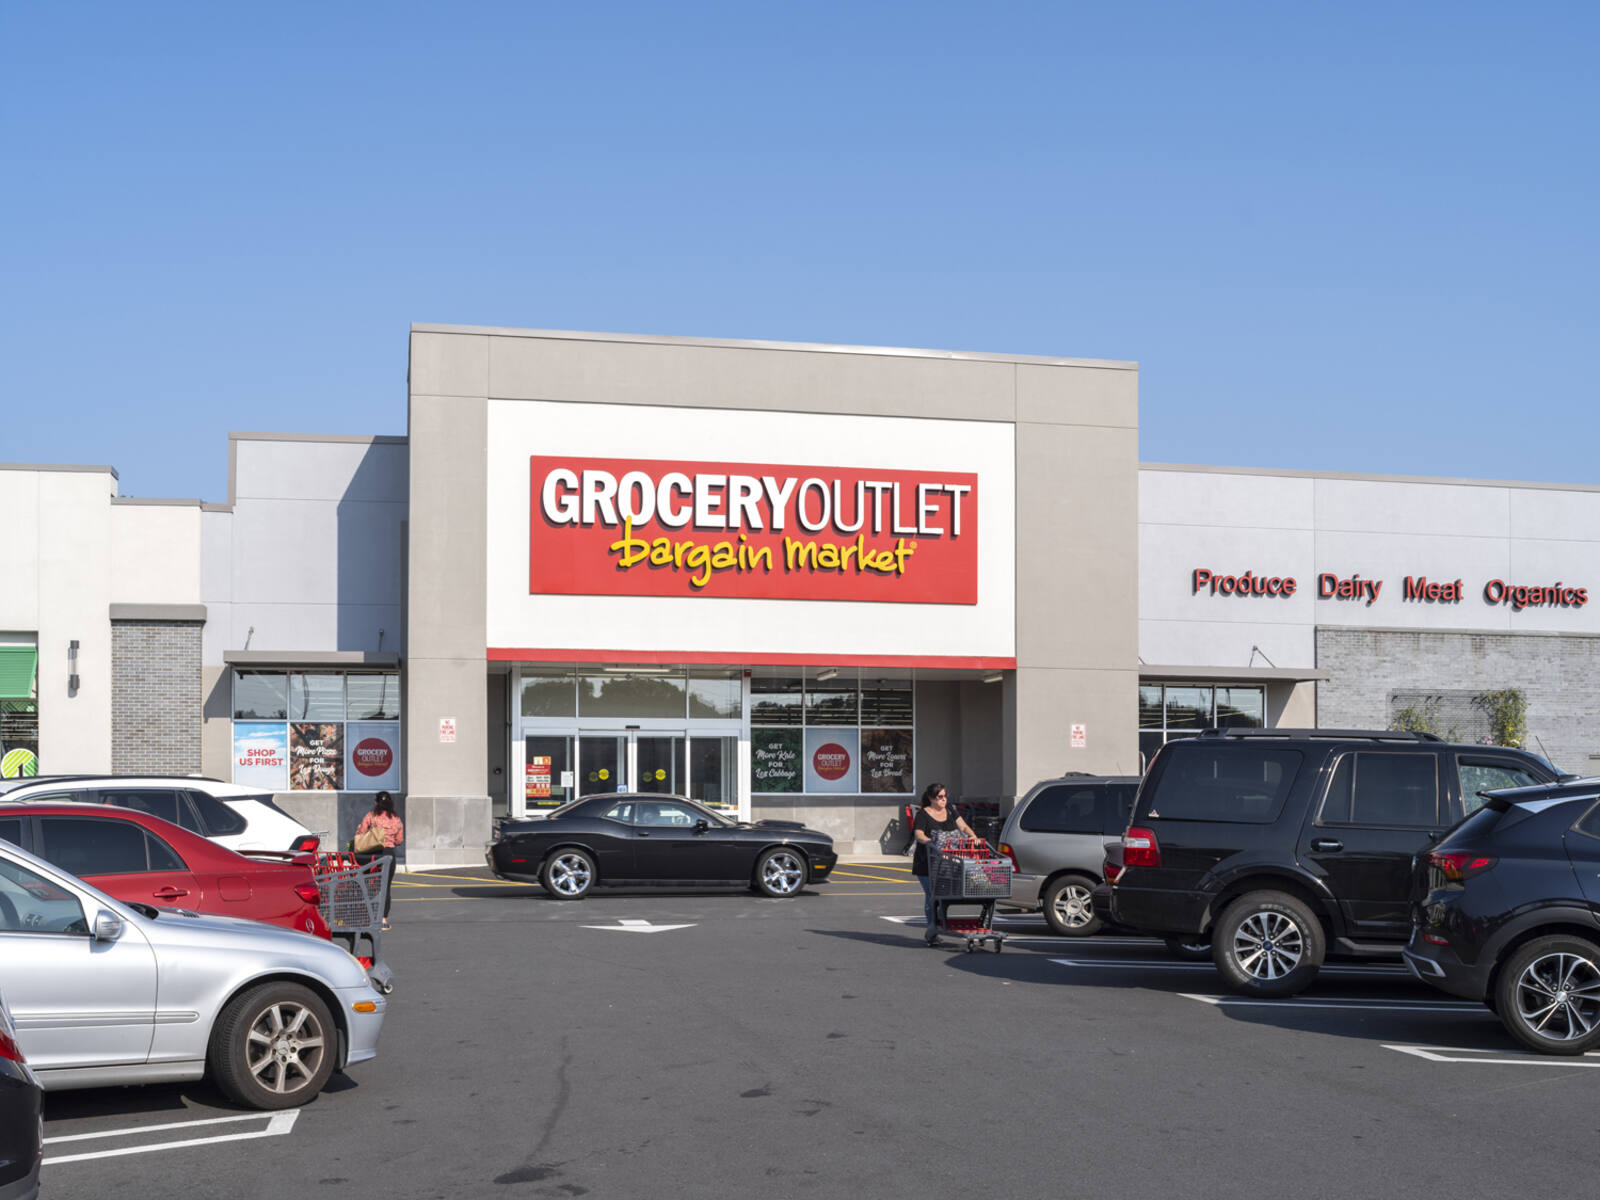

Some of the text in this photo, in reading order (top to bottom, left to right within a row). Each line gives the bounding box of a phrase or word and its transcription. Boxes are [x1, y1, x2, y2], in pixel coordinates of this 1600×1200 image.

[611, 515, 773, 587] bargain
[1193, 568, 1297, 597] Produce
[1319, 573, 1383, 605] Dairy
[1404, 576, 1464, 601] Meat
[1484, 578, 1589, 610] Organics
[239, 757, 284, 766] US FIRST
[247, 748, 276, 757] SHOP
[755, 749, 776, 760] More
[866, 751, 886, 761] More
